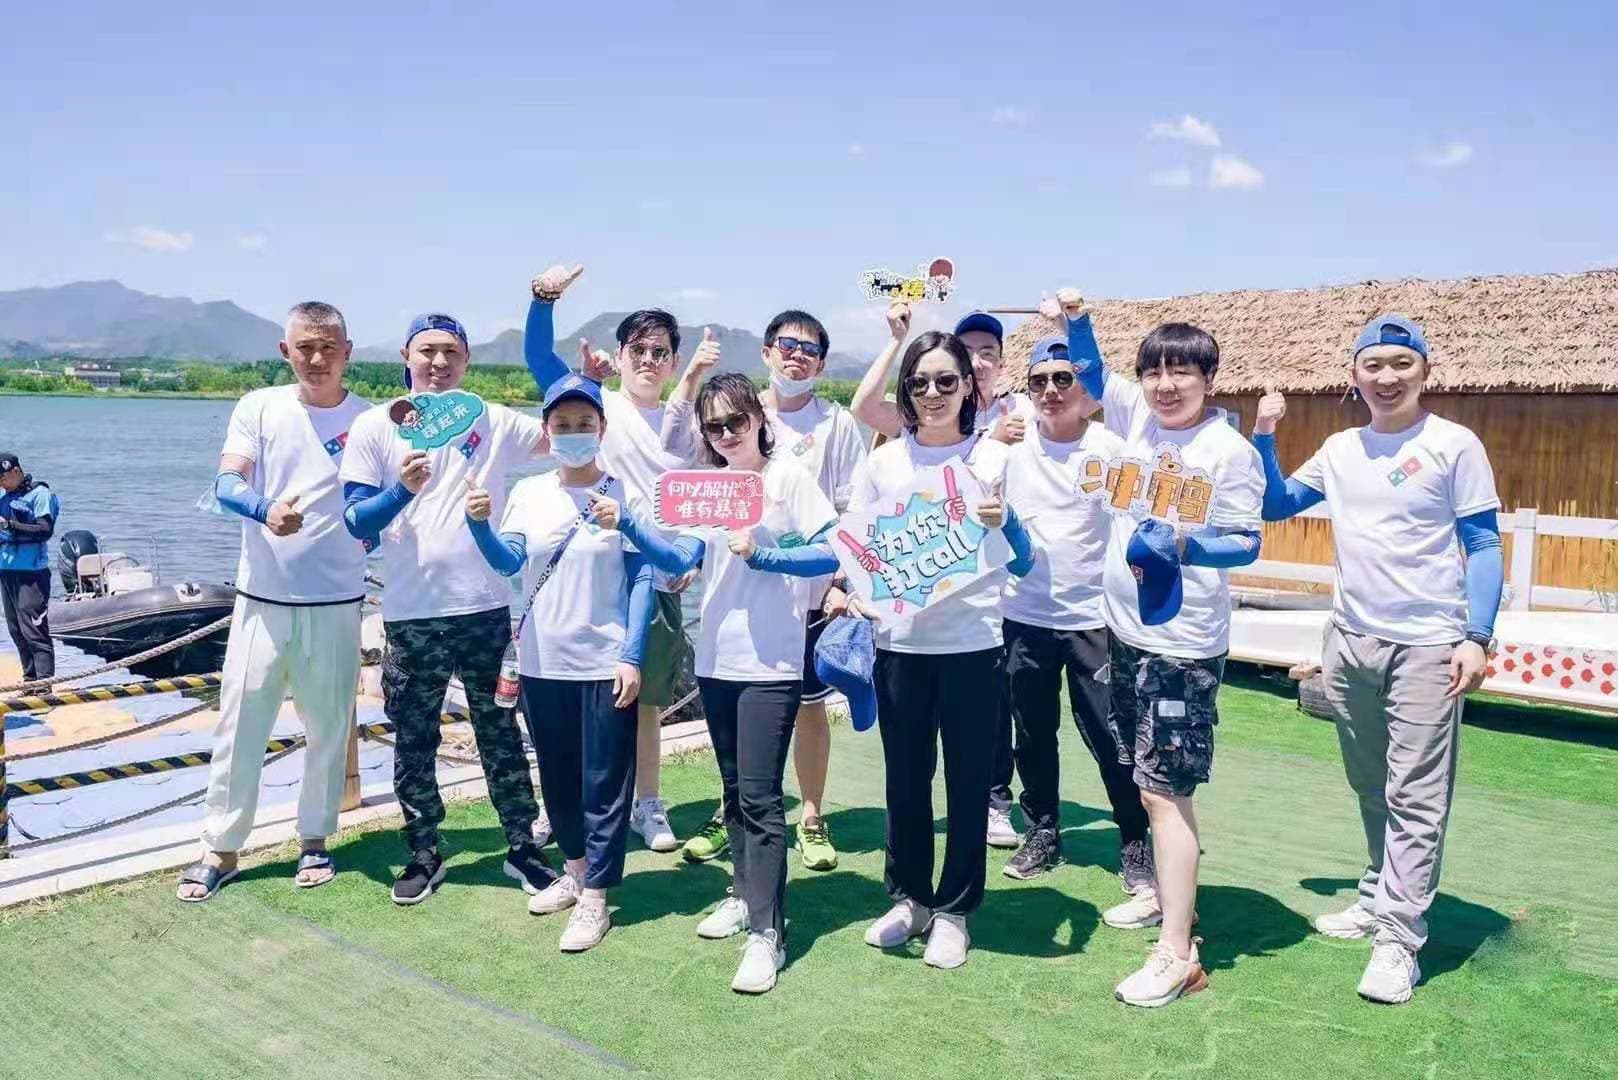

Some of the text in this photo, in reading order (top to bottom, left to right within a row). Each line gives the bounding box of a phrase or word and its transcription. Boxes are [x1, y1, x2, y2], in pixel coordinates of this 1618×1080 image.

[667, 479, 738, 498] 何以解忧
[675, 499, 751, 520] 唯有暴富
[1080, 461, 1213, 524] 冲鸭
[874, 510, 946, 563] 为你
[881, 524, 978, 598] 打call
